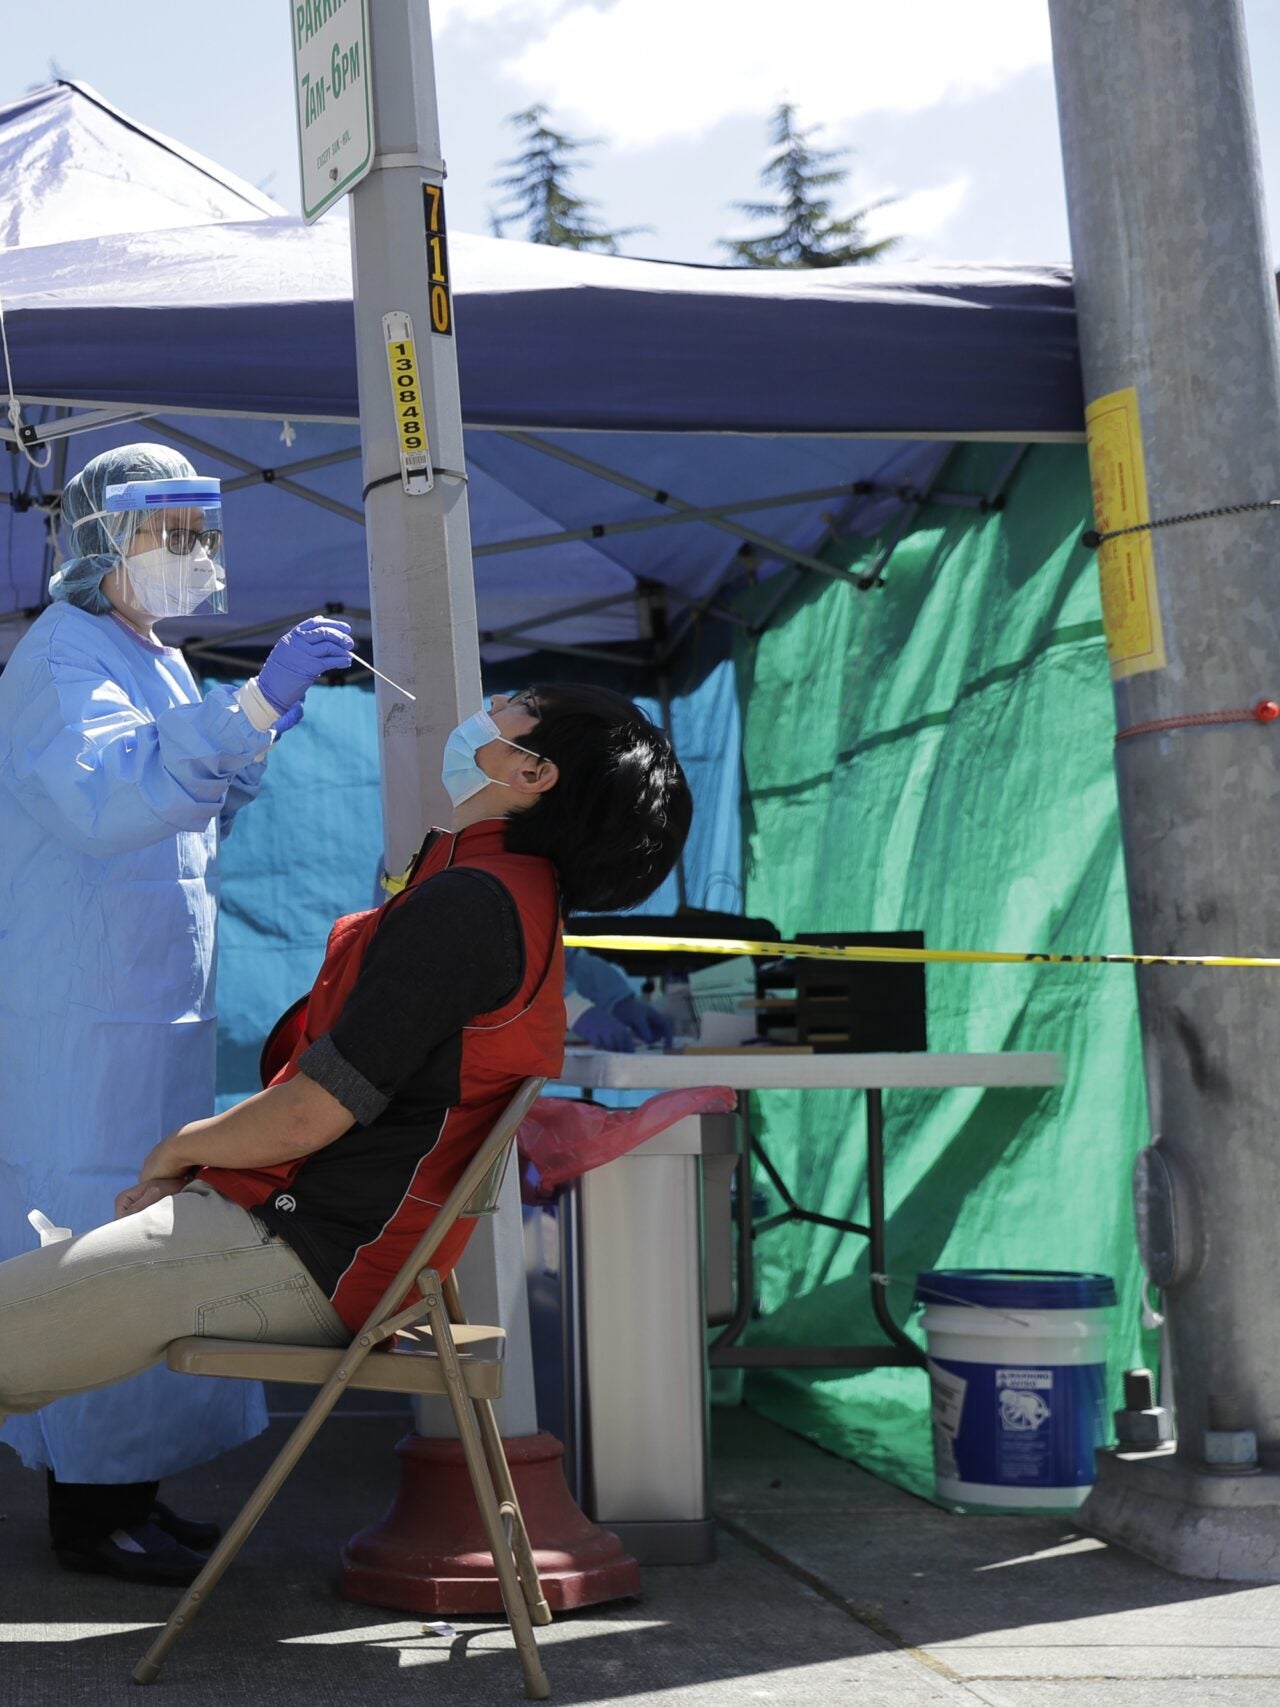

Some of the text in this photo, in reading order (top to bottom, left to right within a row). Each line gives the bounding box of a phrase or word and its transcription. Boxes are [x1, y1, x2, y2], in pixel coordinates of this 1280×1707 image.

[302, 40, 360, 129] 7AM-6PM
[425, 186, 449, 332] 710
[395, 343, 422, 450] 1308489
